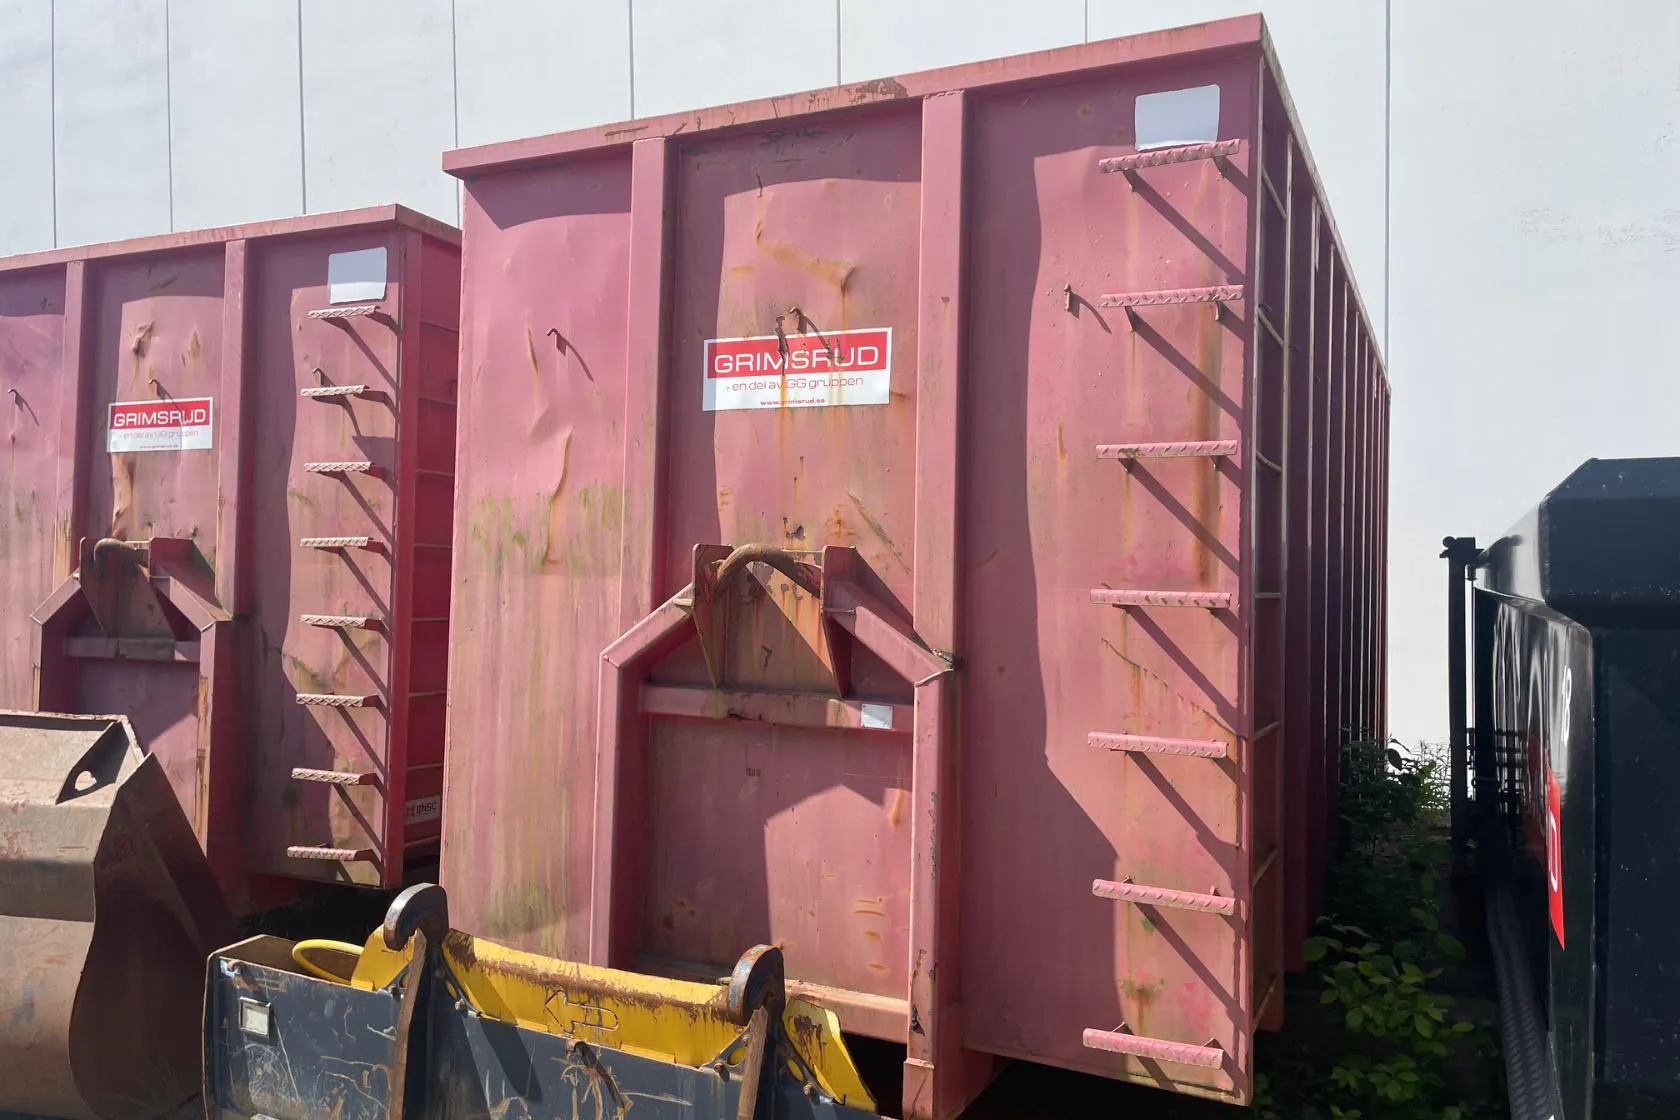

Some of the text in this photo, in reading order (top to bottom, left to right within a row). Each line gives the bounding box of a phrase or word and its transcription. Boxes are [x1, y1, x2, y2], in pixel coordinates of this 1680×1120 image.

[714, 346, 879, 374] GRIMSRUD
[731, 383, 747, 391] en
[748, 381, 767, 391] del
[768, 381, 784, 390] av
[786, 378, 807, 389] GG
[809, 377, 865, 389] gruppen
[113, 408, 206, 427] GRIMSRUD
